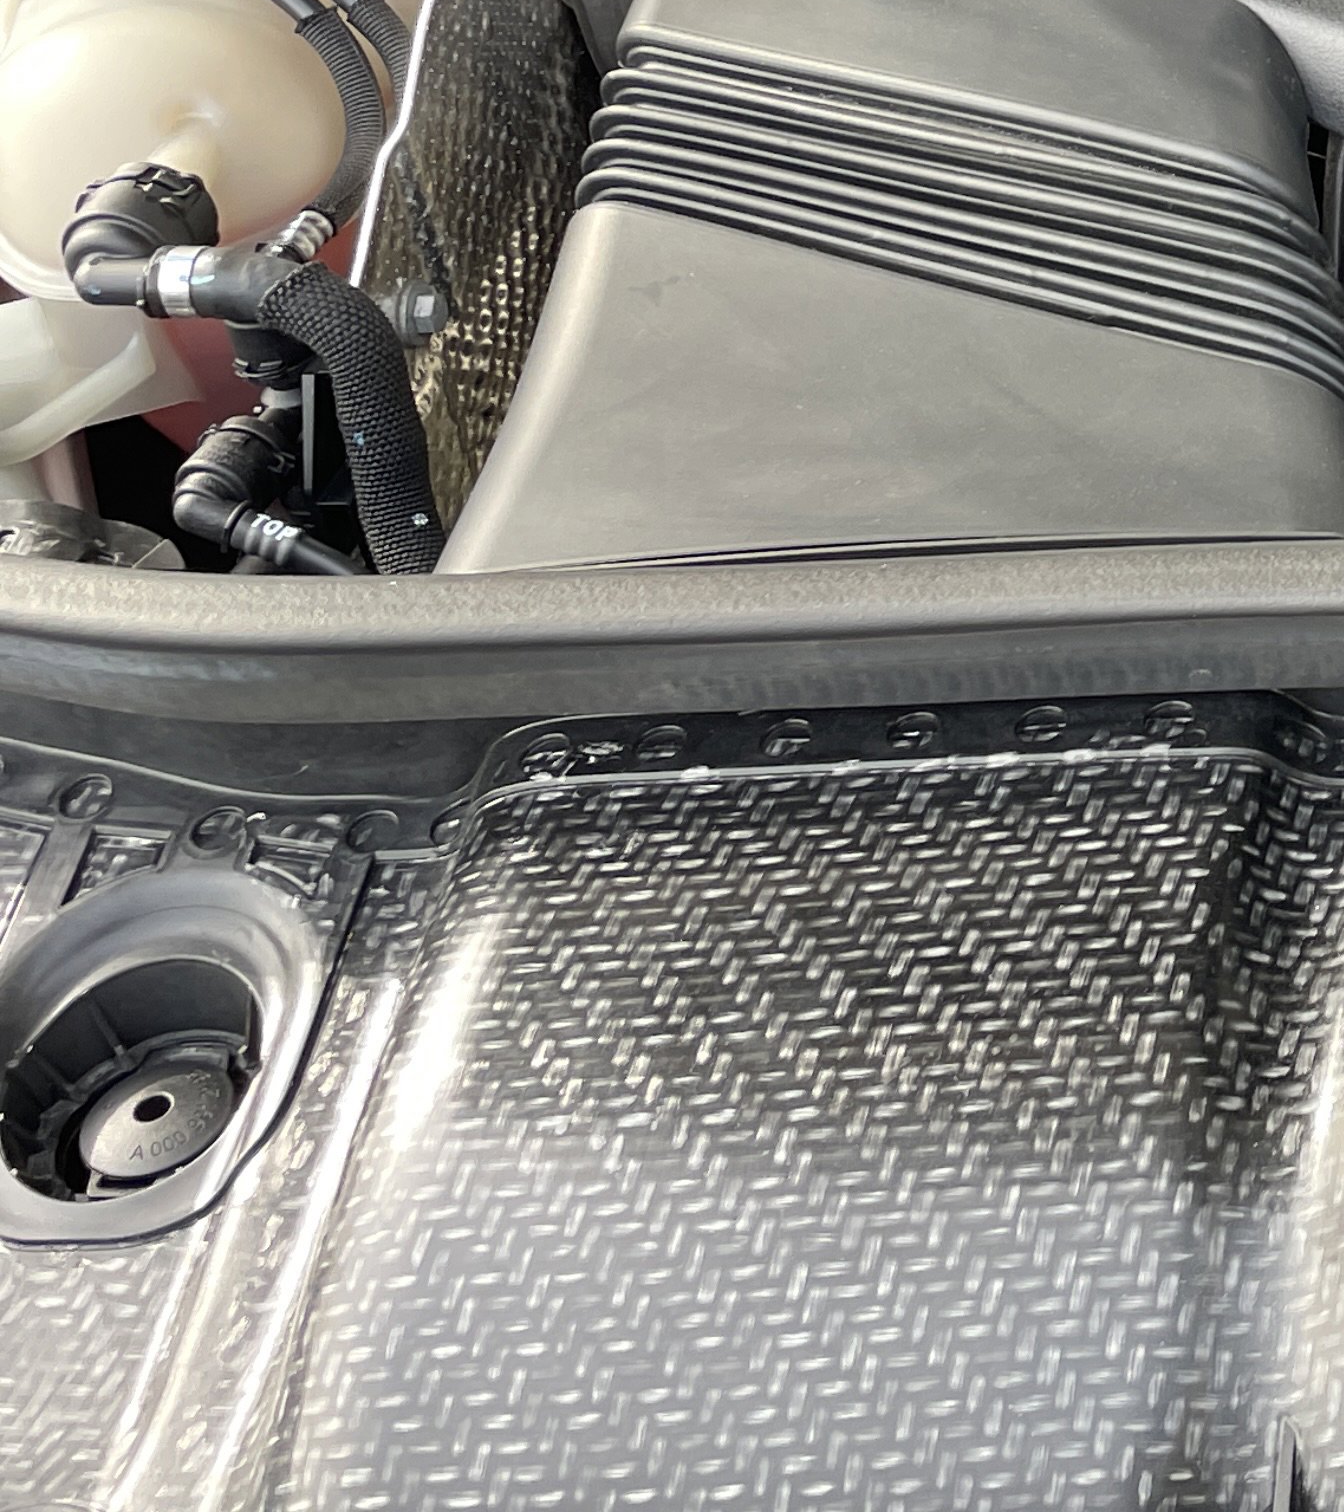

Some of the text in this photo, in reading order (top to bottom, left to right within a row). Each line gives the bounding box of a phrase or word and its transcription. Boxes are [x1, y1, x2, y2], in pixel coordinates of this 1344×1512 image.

[250, 513, 299, 541] TOP
[129, 1144, 144, 1161] A
[150, 1130, 187, 1157] 000
